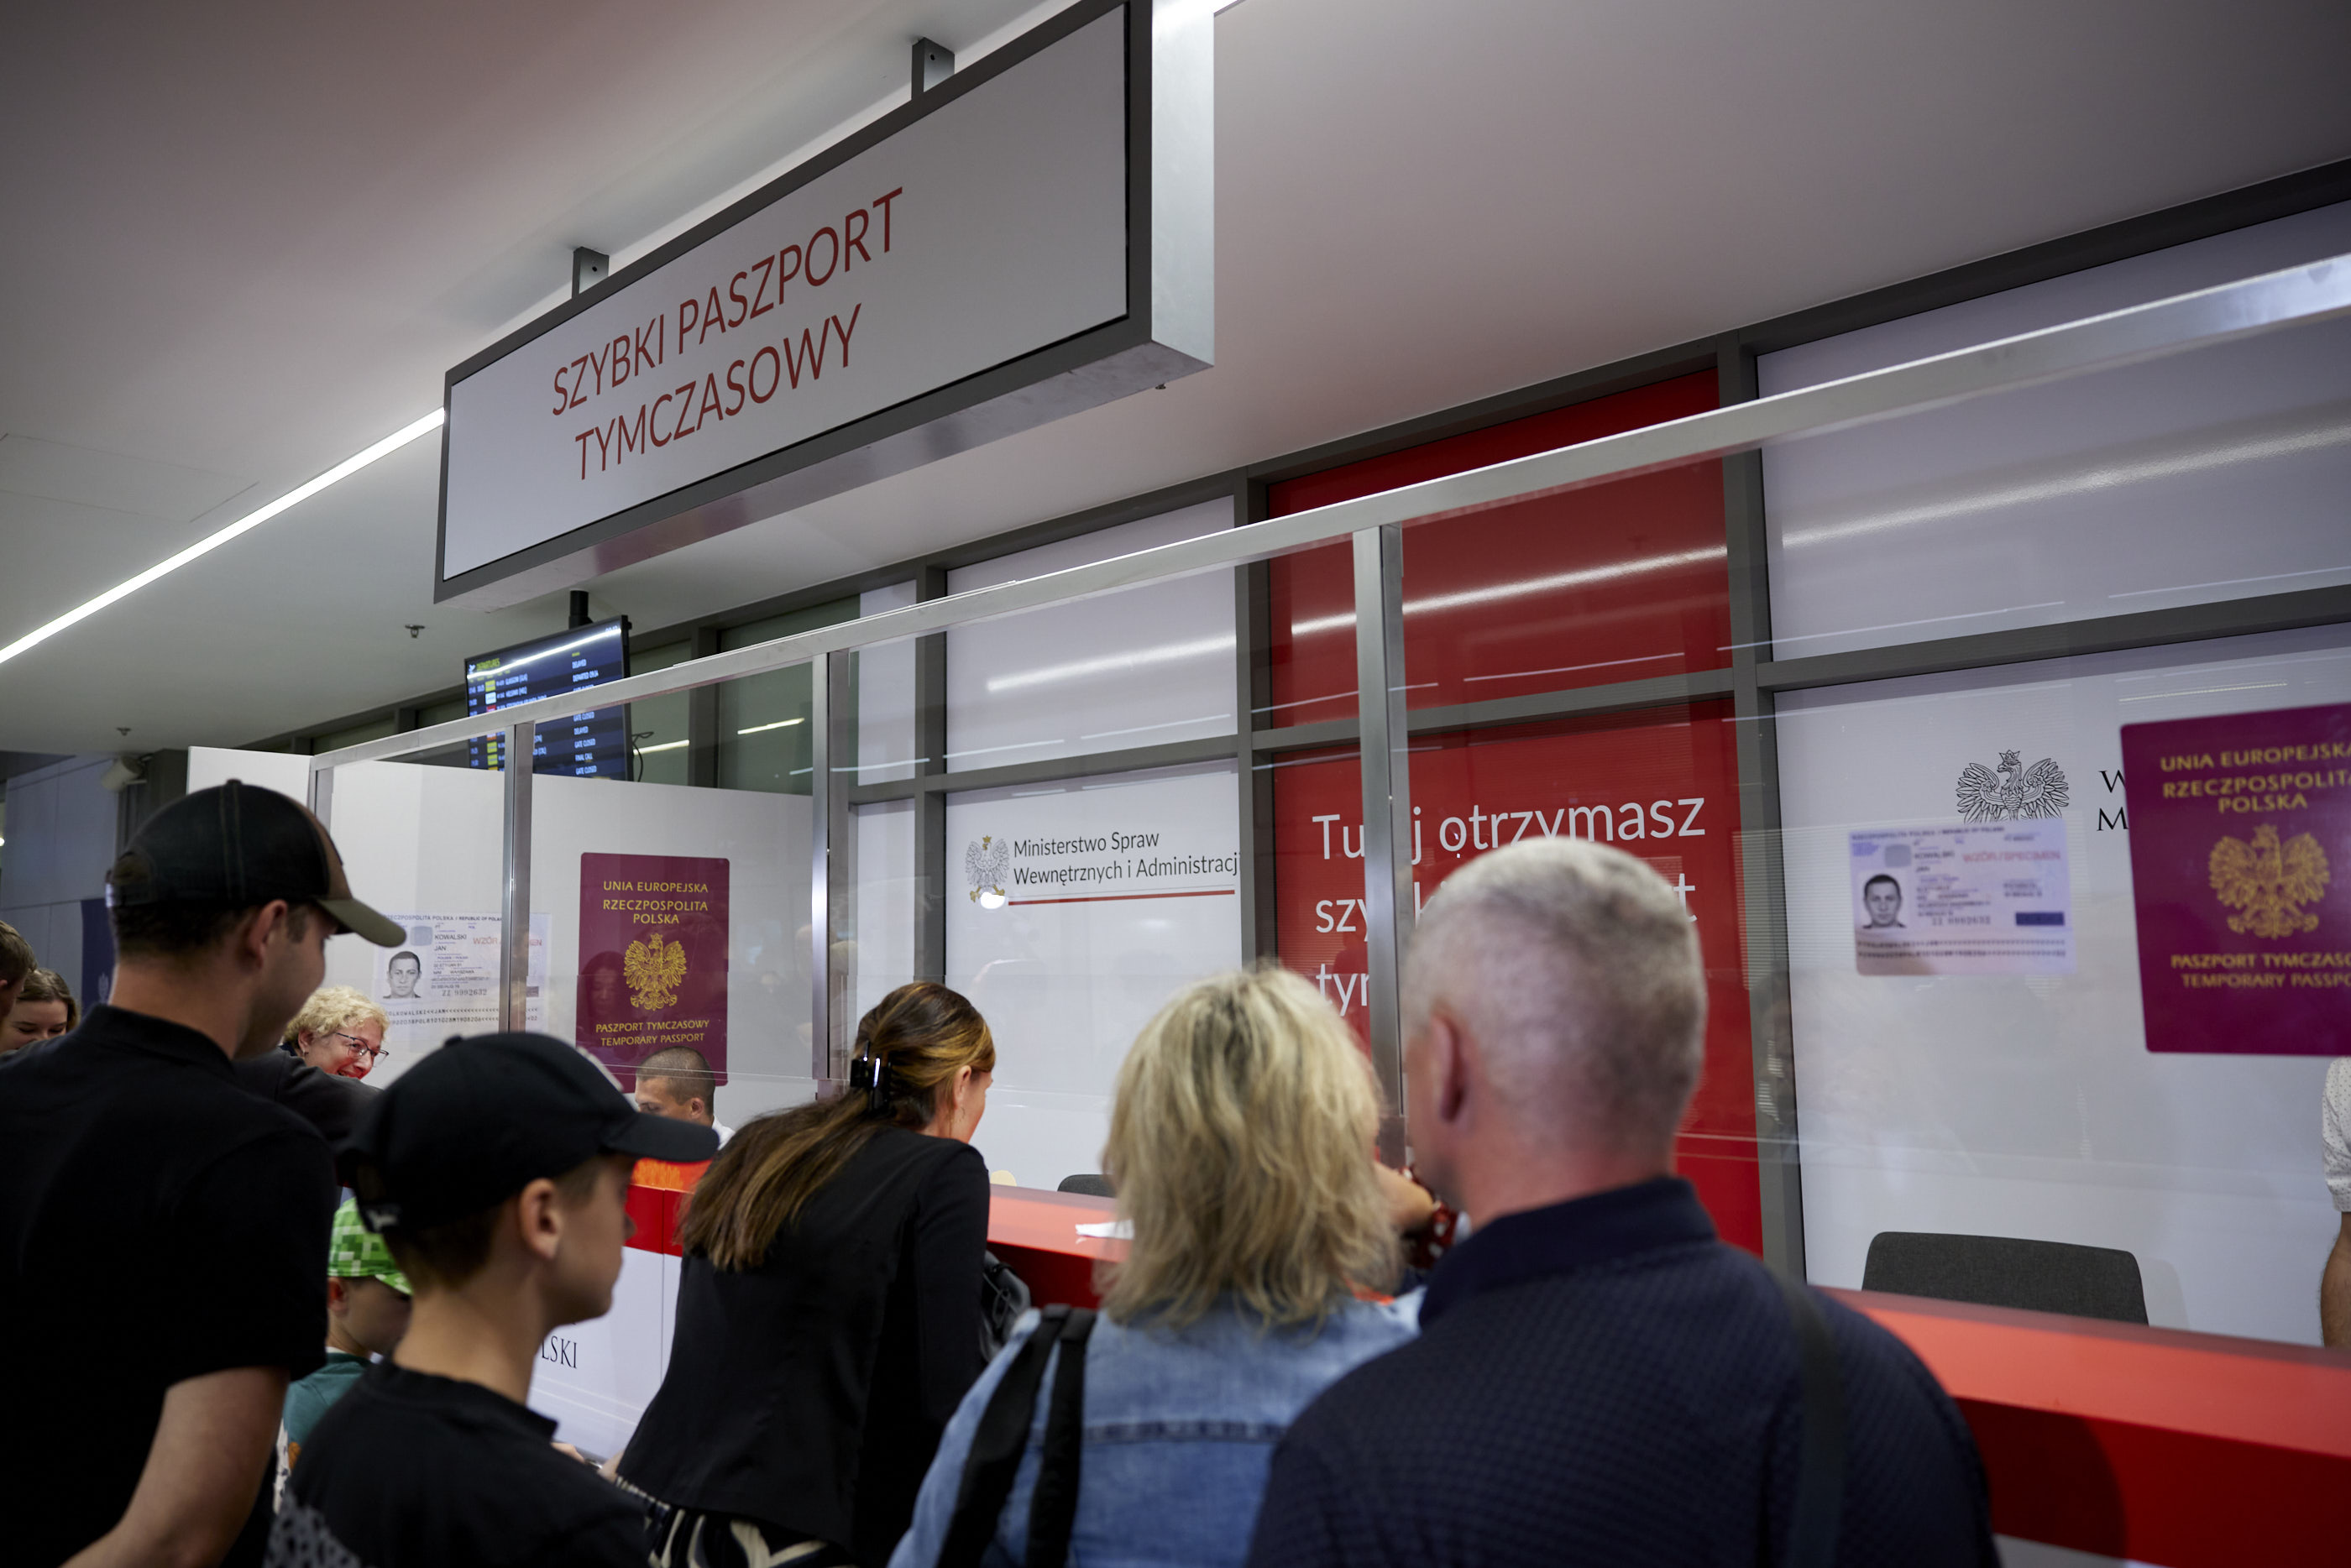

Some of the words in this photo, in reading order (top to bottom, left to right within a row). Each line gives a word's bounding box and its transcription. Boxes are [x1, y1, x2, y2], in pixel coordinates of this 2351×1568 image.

[552, 314, 664, 416] SZYBKI
[678, 186, 903, 354] PASZPORT
[575, 303, 862, 480] TYMCZASOWY
[2160, 754, 2214, 771] UNIA
[2163, 769, 2351, 798] RZECZPOSPOLIT
[2218, 792, 2307, 813] POLSKA
[1013, 836, 1107, 857] Ministerstwo
[1111, 831, 1160, 853] Spraw
[1312, 806, 1422, 865] Tuj
[1013, 860, 1123, 886] Wewnętrznych
[1128, 860, 1131, 878] i
[1136, 852, 1240, 878] Administracj
[604, 881, 633, 891] UNIA
[637, 881, 708, 893] EUROPEJSKA
[603, 900, 708, 912] RZECZPOSPOLITA
[633, 913, 679, 924] POLSKA
[2171, 953, 2255, 969] PASZPORT
[2262, 952, 2351, 969] TYMCZAS
[2181, 973, 2286, 989] TEMPORARY
[2291, 972, 2351, 989] PASSP
[595, 1022, 642, 1032] PASZPORT
[647, 1020, 709, 1031] TYMCZASOWY
[601, 1035, 657, 1046] TEMPORARY
[661, 1033, 704, 1043] PASSPORT
